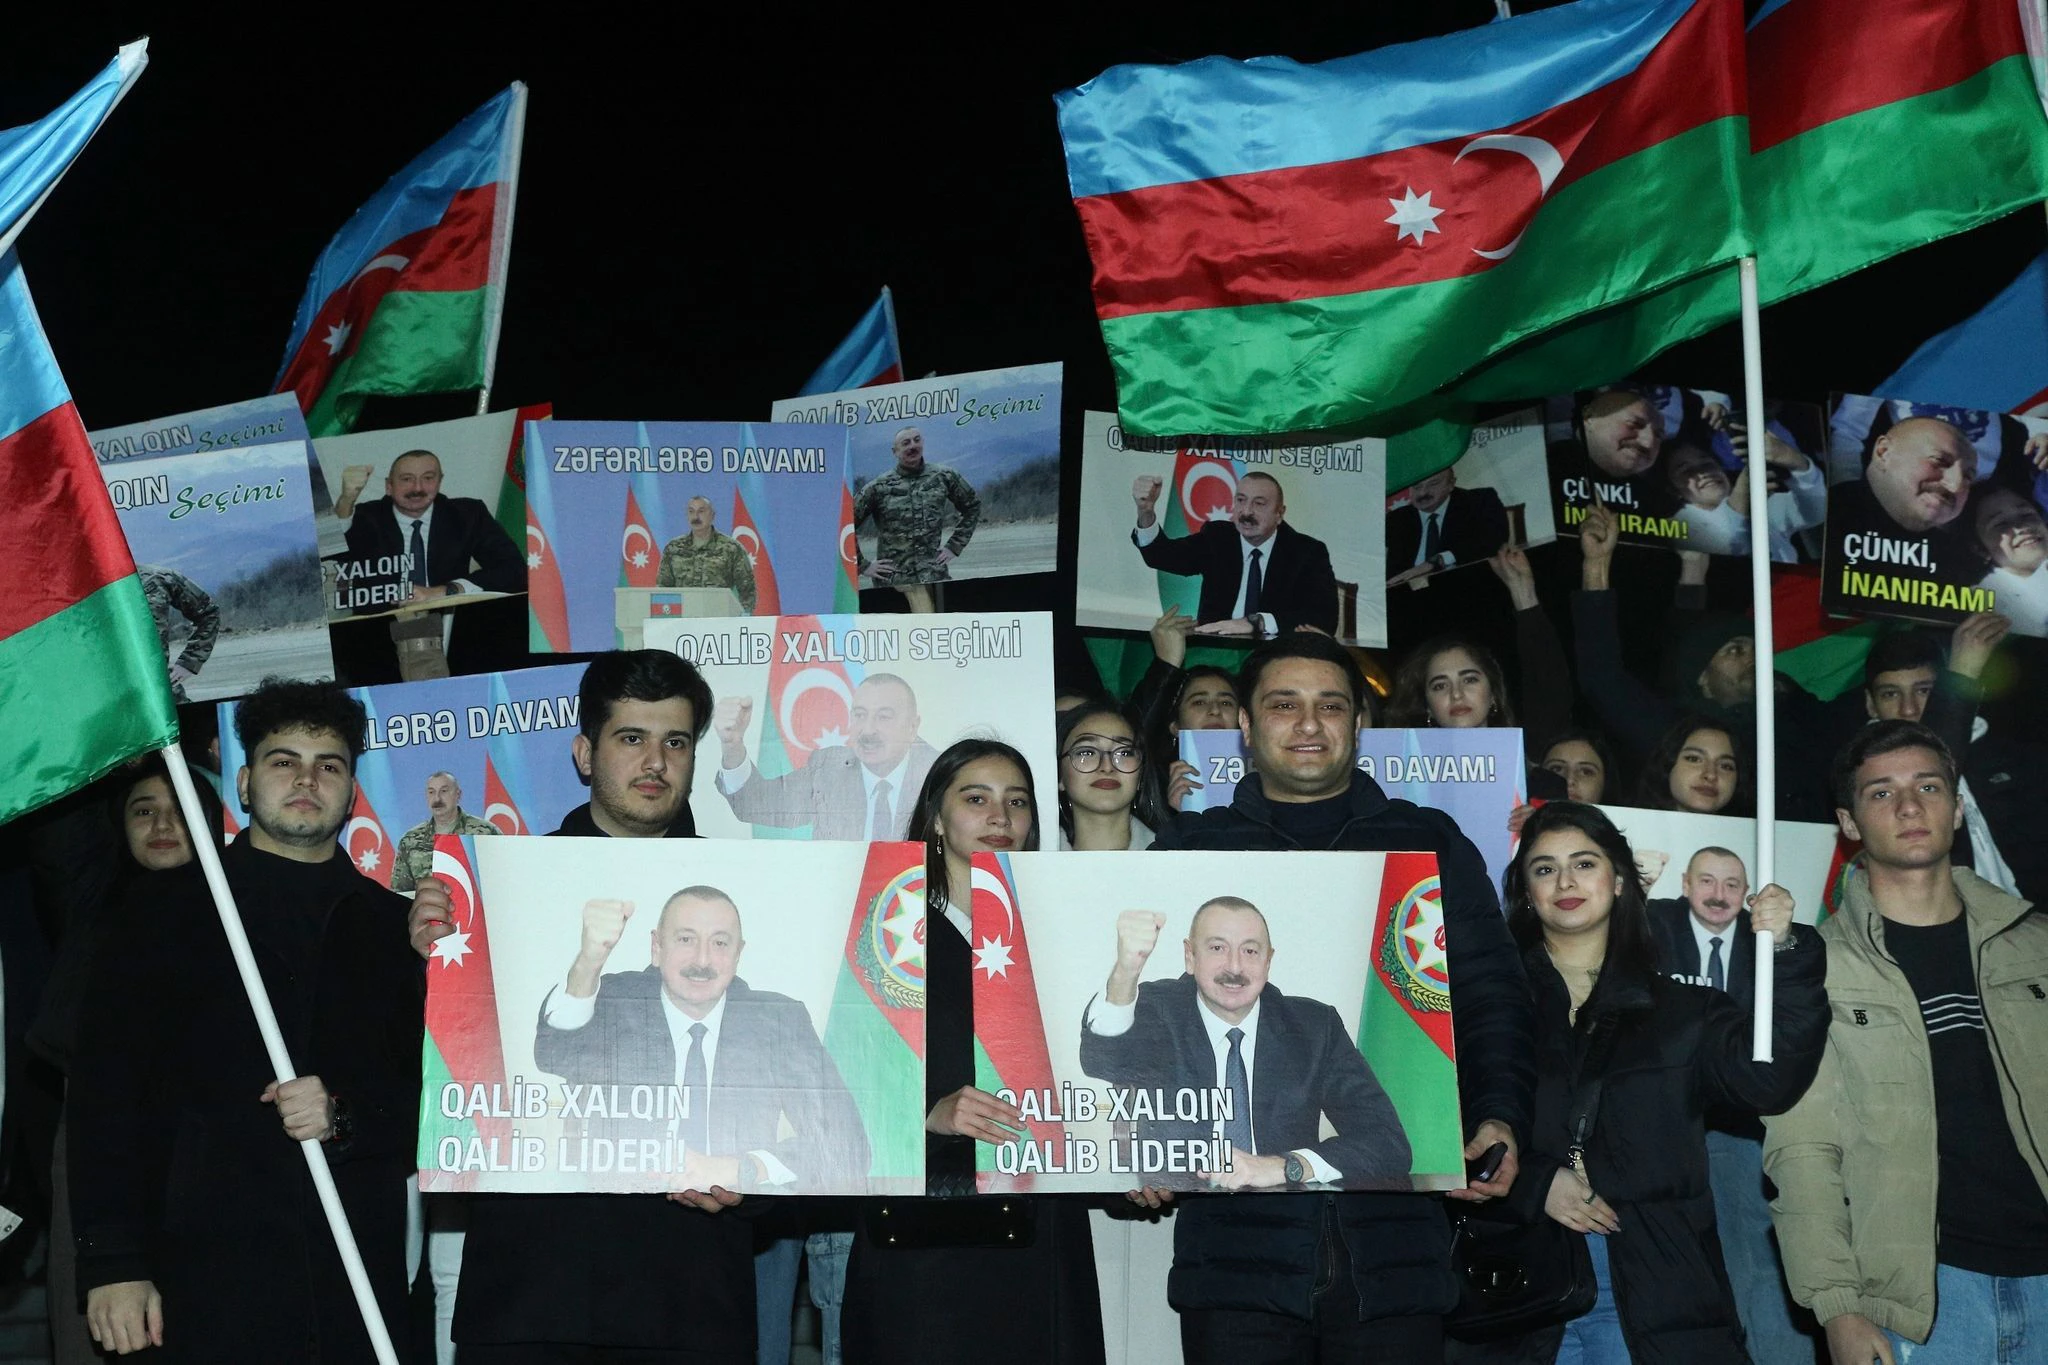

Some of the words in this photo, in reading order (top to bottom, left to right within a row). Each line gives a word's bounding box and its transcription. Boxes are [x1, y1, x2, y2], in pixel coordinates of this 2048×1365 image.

[865, 388, 959, 425] XALQIN
[956, 393, 1044, 427] Seçimi
[553, 447, 714, 473] ZƏFƏRLƏRƏ
[722, 447, 826, 473] DAVAM!
[1185, 435, 1273, 464] XALQIN
[1279, 444, 1363, 475] SEÇİMİ
[107, 474, 170, 511] QIN
[168, 478, 286, 520] Seçimi
[1564, 502, 1688, 539] İNIRAM!
[335, 552, 415, 581] XALQIN
[1843, 531, 1937, 574] ÇÜNKİ,
[335, 577, 414, 610] LİDERİ!
[1841, 565, 1995, 613] İNANIRAM!
[675, 626, 772, 669] QALİB
[781, 629, 900, 664] XALQIN
[909, 619, 1022, 668] SEÇİMİ
[363, 709, 457, 750] LƏRƏ
[1384, 755, 1497, 783] DAVAM!
[440, 1076, 549, 1121] QALİB
[557, 1082, 691, 1121] XALQIN
[1107, 1087, 1234, 1124] XALQIN
[437, 1129, 546, 1175] QALİB
[557, 1130, 686, 1174] LİDERİ!
[994, 1131, 1099, 1176] QALİB
[1109, 1131, 1234, 1174] LİDERİ!
